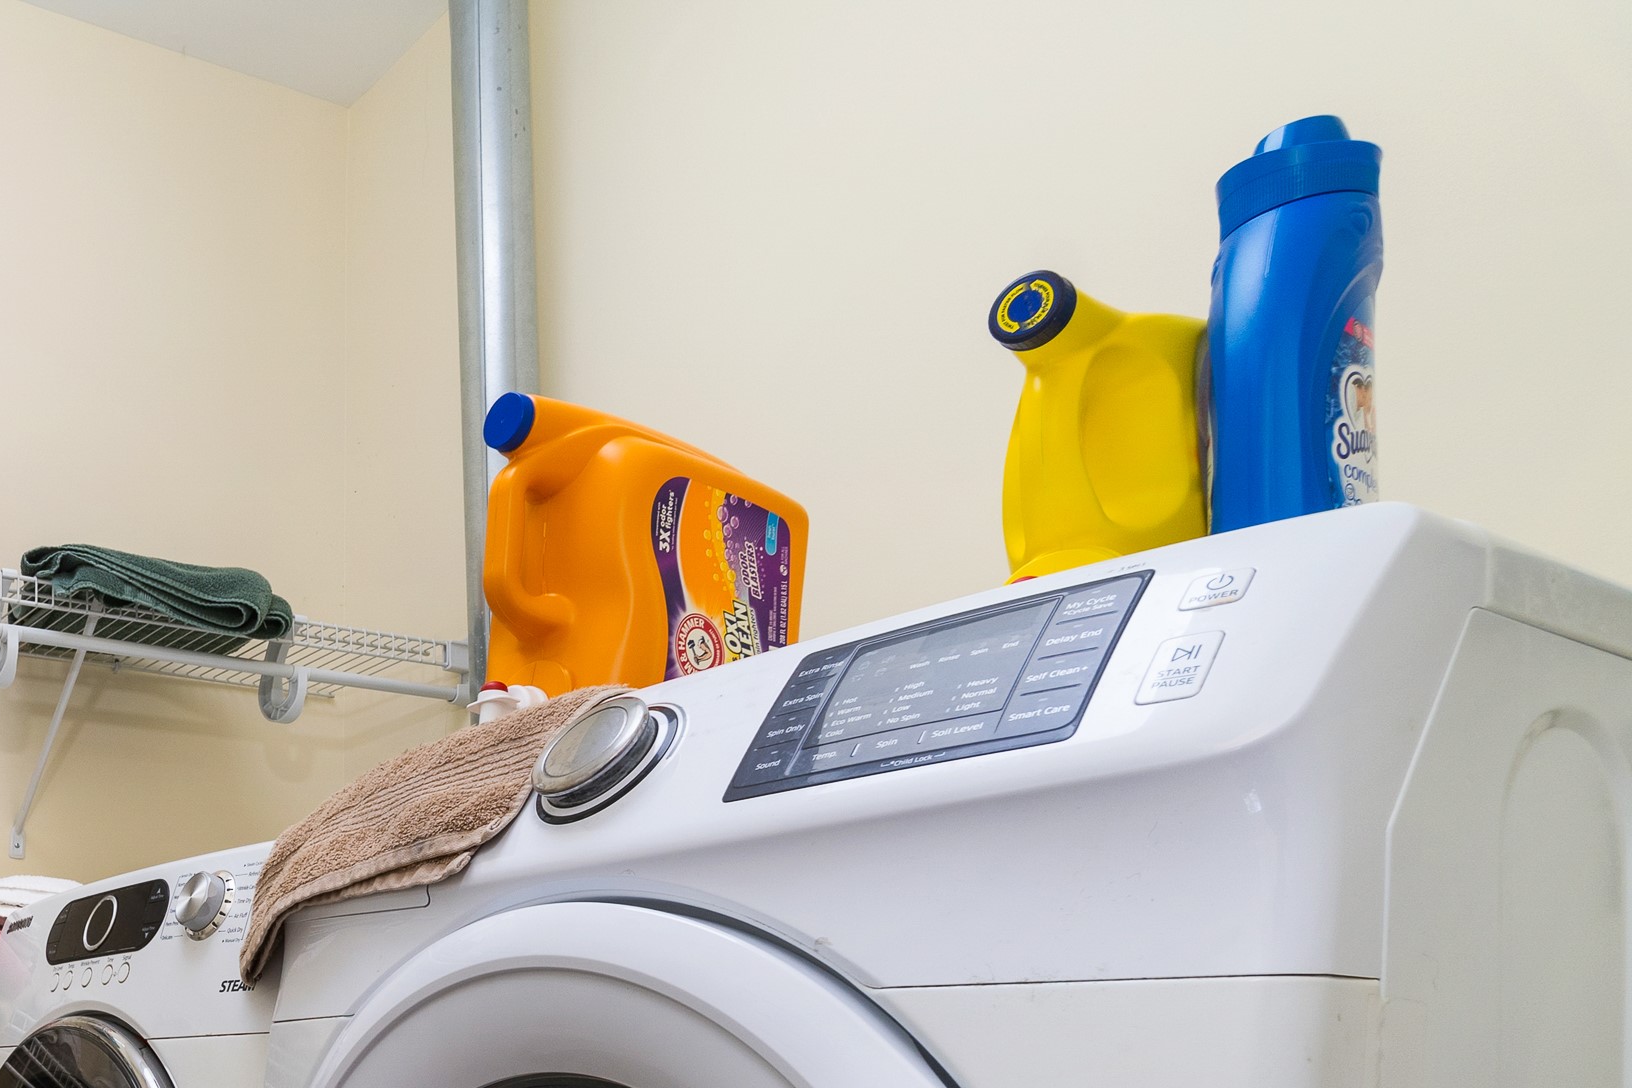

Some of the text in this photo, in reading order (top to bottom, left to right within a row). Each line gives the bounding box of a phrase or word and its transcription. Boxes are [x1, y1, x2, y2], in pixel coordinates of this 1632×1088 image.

[665, 492, 674, 529] fighters
[659, 529, 670, 553] 3X
[740, 552, 750, 586] ODOR
[746, 542, 762, 599] BLASTERS
[1065, 593, 1117, 611] My Cycle
[1188, 590, 1239, 603] POWER
[1092, 601, 1114, 611] Save
[678, 618, 705, 650] HAMMER
[724, 611, 742, 654] OXI
[1046, 628, 1104, 647] Delay End
[1002, 640, 1020, 649] End
[680, 652, 688, 662] &
[798, 660, 844, 678] Extra Rinse
[1158, 665, 1200, 678] START
[966, 676, 999, 688] Heavy
[1025, 672, 1047, 683] Self
[1151, 677, 1195, 689] PAUSE
[903, 681, 925, 691] High
[898, 690, 934, 702] Medium
[961, 687, 998, 700] Normal
[782, 692, 824, 708] Extra Spin
[842, 696, 858, 705] Hot
[838, 706, 862, 715] Warm
[892, 704, 912, 714] Low
[954, 702, 982, 712] Light
[1008, 704, 1071, 722] Smart Care
[830, 712, 872, 726] Eco Warm
[900, 713, 921, 722] Spin
[766, 723, 806, 738] Spin Only
[825, 728, 844, 738] Cold
[930, 722, 984, 738] Soil Level
[875, 738, 898, 748] Spin
[914, 754, 934, 763] Lock
[755, 760, 780, 770] Sound
